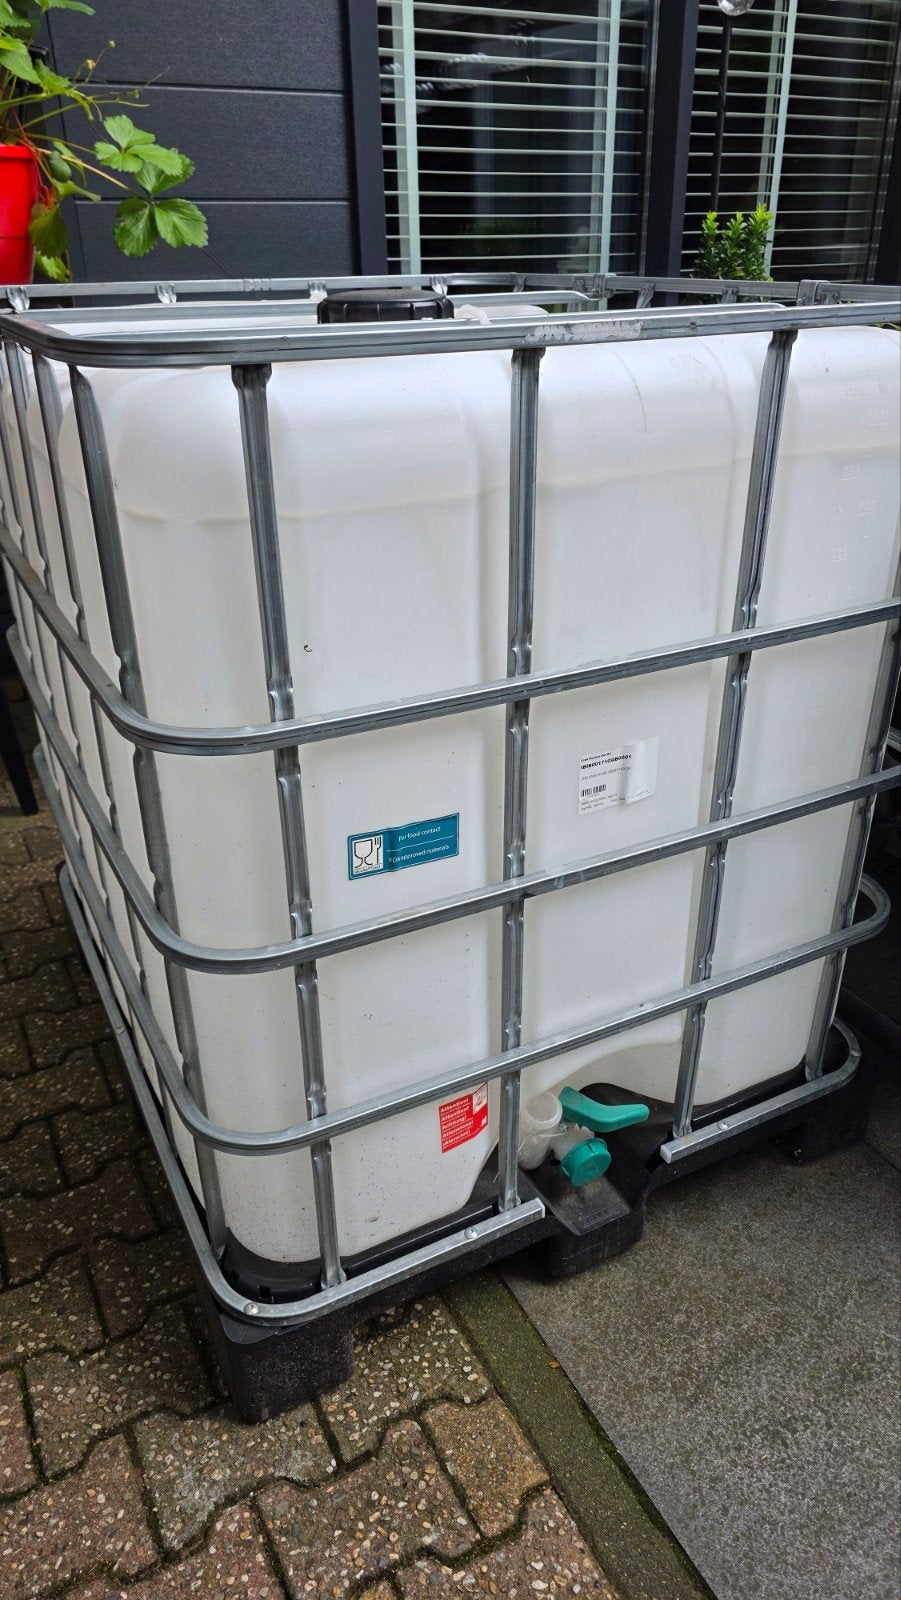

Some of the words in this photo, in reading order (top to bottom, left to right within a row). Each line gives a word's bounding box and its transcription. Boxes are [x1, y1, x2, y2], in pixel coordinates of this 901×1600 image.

[398, 834, 407, 842] For
[407, 831, 420, 839] food
[420, 826, 441, 836] contact
[401, 850, 425, 862] approved
[425, 845, 450, 855] materials
[441, 1115, 467, 1130] Achtung!
